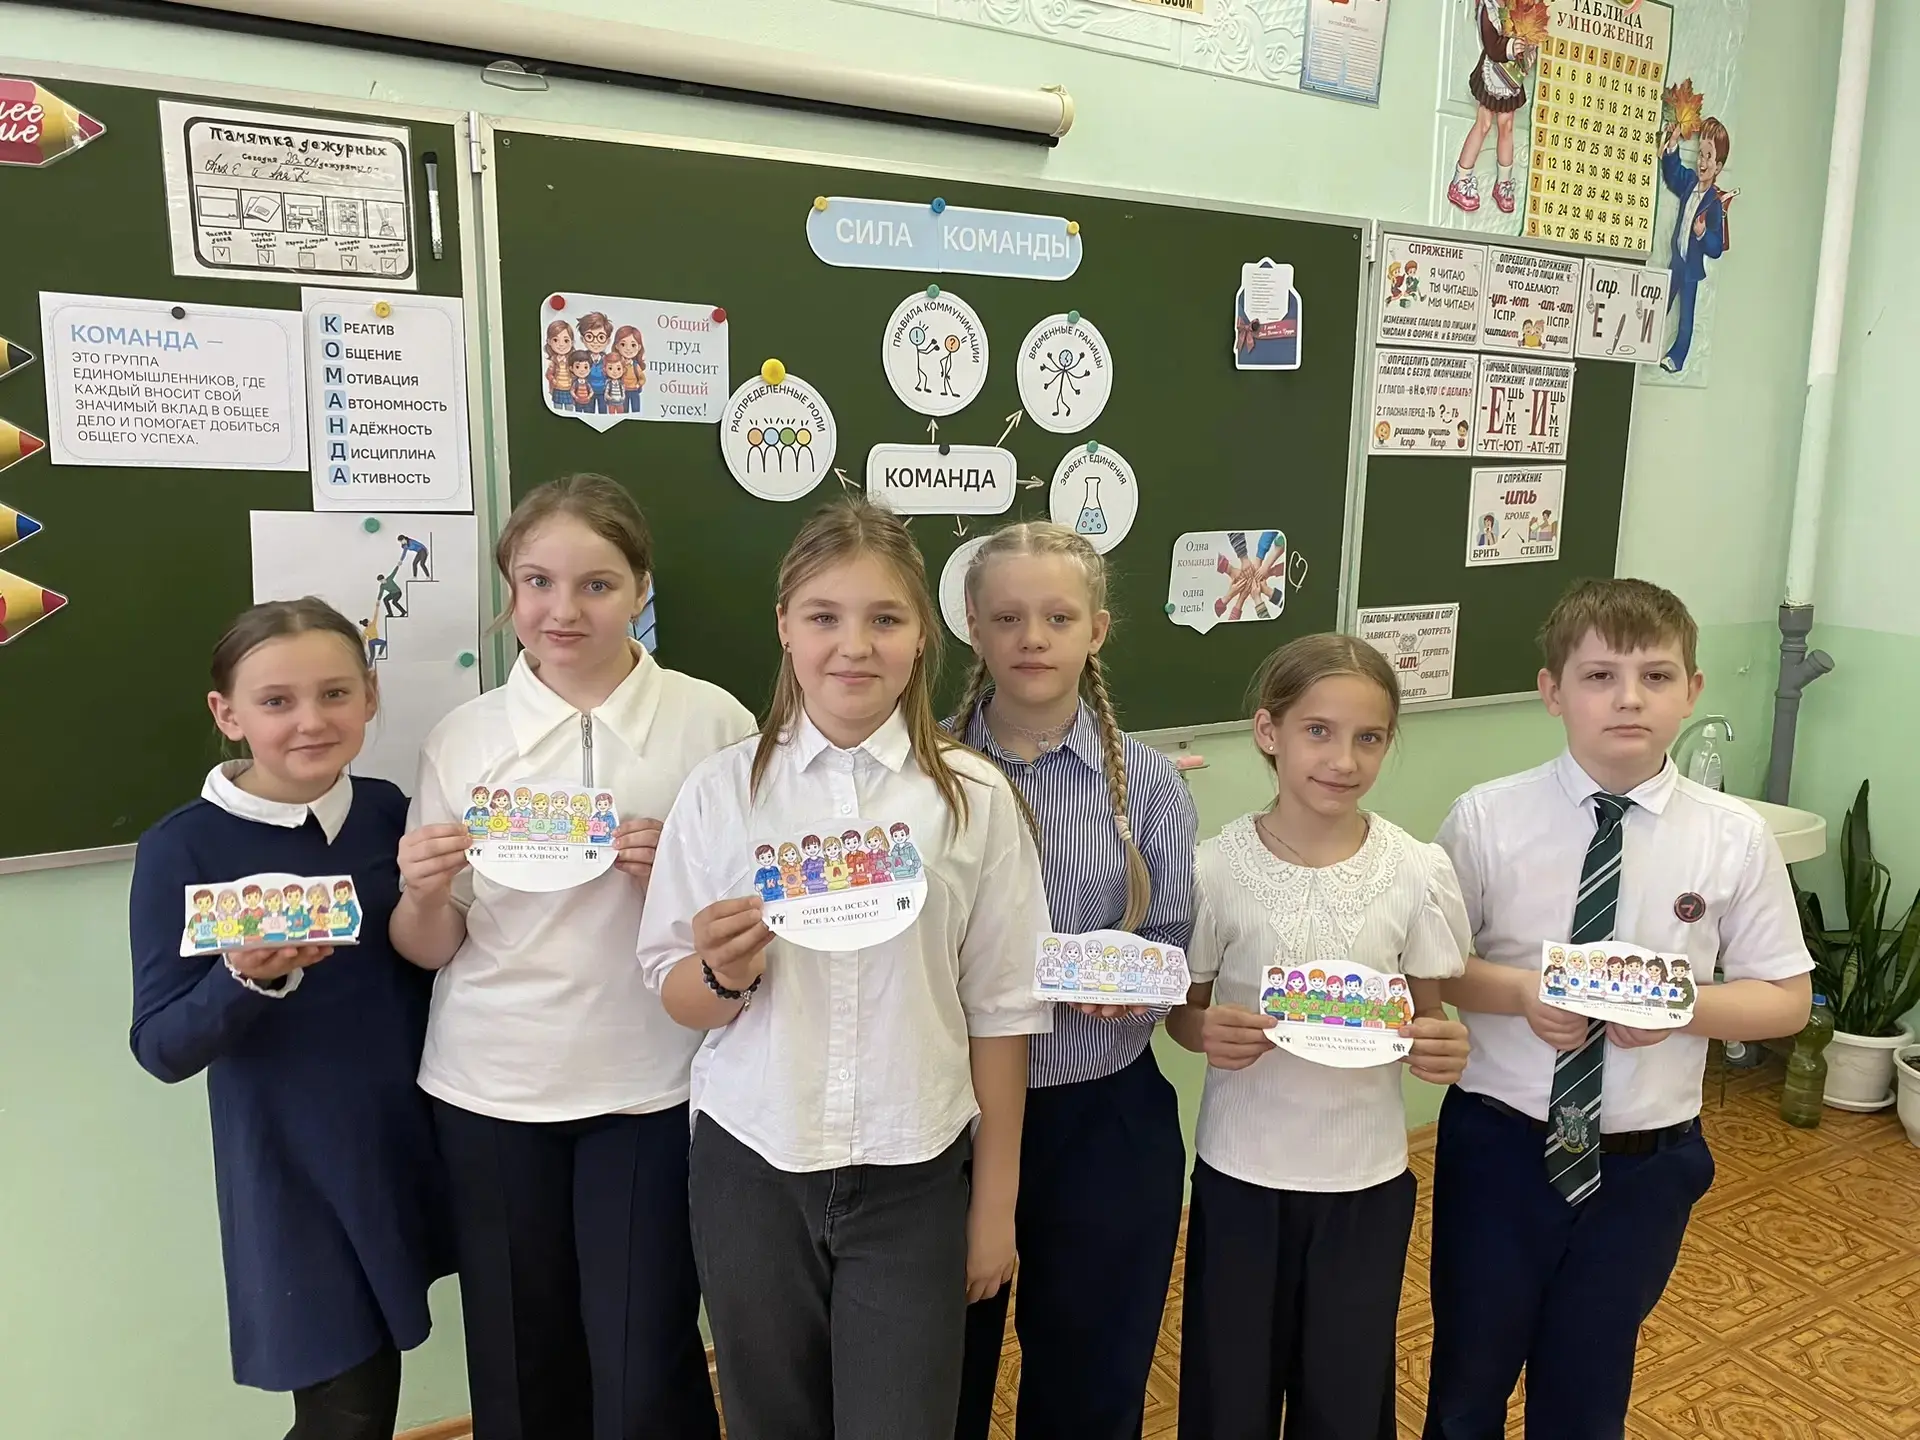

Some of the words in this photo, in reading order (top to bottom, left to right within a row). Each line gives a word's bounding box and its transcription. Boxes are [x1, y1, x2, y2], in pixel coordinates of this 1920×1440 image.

[1558, 12, 1654, 49] УМНОЖЕНИЯ
[209, 127, 294, 148] Памятка
[299, 138, 387, 156] дежурных
[242, 153, 277, 164] Сегодня
[1535, 154, 1541, 166] 6
[1547, 158, 1557, 168] 12
[1562, 160, 1572, 172] 18
[1575, 162, 1585, 174] 24
[1588, 166, 1598, 176] 30
[1601, 168, 1611, 180] 36
[1614, 170, 1624, 182] 42
[1627, 172, 1637, 184] 48
[1641, 174, 1650, 186] 54
[836, 218, 913, 247] СИЛА
[944, 226, 1070, 261] КОМАНДЫ
[1530, 222, 1537, 234] 9
[1543, 224, 1552, 236] 18
[1555, 226, 1566, 238] 27
[1569, 228, 1579, 240] 36
[1583, 230, 1593, 242] 45
[1596, 232, 1606, 244] 54
[1609, 234, 1619, 246] 63
[1623, 236, 1633, 248] 72
[1637, 238, 1646, 250] 81
[1408, 243, 1463, 259] СПРЯЖЕНИЕ
[1495, 265, 1504, 273] ПО
[1505, 266, 1526, 275] ФОРМЕ
[1500, 254, 1537, 268] ОПРЕДЕЛИТЬ
[1538, 258, 1572, 272] СПРЯЖЕНИЕ
[1430, 268, 1436, 277] Я
[1438, 269, 1465, 281] ЧИТАЮ
[1430, 282, 1440, 293] ТЫ
[1442, 285, 1478, 297] ЧИТАЕШЬ
[1508, 280, 1524, 290] ЧТО
[1525, 282, 1559, 295] ДЕЛАЮТ?
[1596, 278, 1620, 299] спр.
[1641, 285, 1663, 304] спр.
[1428, 298, 1442, 307] МЫ
[1444, 299, 1474, 310] ЧИТАЕМ
[658, 314, 710, 332] Общий
[1384, 315, 1417, 326] ИЗМЕНЕНИЕ
[1593, 302, 1605, 338] Е
[1640, 308, 1654, 344] И
[71, 324, 199, 352] КОМАНДА
[893, 306, 923, 347] ПРАВИЛА
[924, 301, 980, 363] КОММУНИКАЦИИ
[667, 341, 700, 355] труд
[1029, 326, 1073, 360] ВРЕМЕННЫЕ
[1074, 329, 1103, 368] ГРАНИЦЫ
[72, 352, 100, 363] ЭТО
[104, 354, 159, 367] ГРУППА
[1388, 355, 1429, 366] ОПРЕДЕЛИТЬ
[1430, 357, 1467, 368] СПРЯЖЕНИЕ
[649, 360, 719, 375] приносит
[1379, 366, 1405, 376] ГЛАГОЛА
[1511, 364, 1542, 375] ОКОНЧАНИЯ
[1543, 366, 1569, 378] ГЛАГОЛОВ
[73, 368, 239, 388] ЕДИНОМЫШЛЕННИКОВ,
[242, 377, 266, 389] ГДЕ
[1490, 374, 1525, 385] СПРЯЖЕНИЕ
[1535, 378, 1568, 389] СПРЯЖЕНИЕ
[74, 384, 140, 398] КАЖДЫЙ
[144, 387, 201, 400] ВНОСИТ
[205, 387, 241, 401] СВОЙ
[660, 380, 708, 395] общий
[1508, 388, 1524, 399] ШЬ
[1551, 391, 1566, 402] ШЬ
[75, 399, 157, 414] ЗНАЧИМЫЙ
[162, 404, 208, 416] ВКЛАД
[212, 405, 220, 415] В
[223, 406, 269, 419] ОБЩЕЕ
[660, 403, 707, 417] успех!
[731, 384, 809, 432] РАСПРЕДЕЛЕННЫЕ
[807, 402, 825, 432] РОЛИ
[1507, 400, 1513, 410] Т
[1551, 403, 1556, 413] Т
[77, 415, 115, 428] ДЕЛО
[120, 417, 130, 427] И
[134, 418, 206, 430] ПОМОГАЕТ
[210, 420, 280, 433] ДОБИТЬСЯ
[1506, 412, 1515, 422] М
[1550, 415, 1558, 425] М
[1394, 427, 1425, 437] решать
[1505, 424, 1516, 435] ТЕ
[1549, 427, 1559, 437] ТЕ
[78, 430, 137, 444] ОБЩЕГО
[141, 432, 199, 445] УСПЕХА.
[1061, 455, 1087, 485] ЭФФЕКТ
[1090, 454, 1126, 485] ЕДИНЕНИЯ
[885, 468, 996, 492] КОМАНДА
[1504, 473, 1542, 483] СПРЯЖЕНИЕ
[1500, 490, 1537, 505] -ить
[1505, 512, 1530, 520] КРОМЕ
[1186, 541, 1209, 552] Одна
[1473, 548, 1500, 558] БРИТЬ
[1521, 545, 1554, 555] СТЕЛИТЬ
[1177, 558, 1215, 567] команда
[1183, 588, 1204, 598] одна
[1180, 602, 1204, 613] цель!
[1362, 611, 1434, 624] ГЛАГОЛЫ-ИСКЛЮЧЕНИЯ
[1365, 631, 1400, 640] ЗАВИСЕТЬ
[1418, 627, 1451, 636] СМОТРЕТЬ
[1422, 648, 1449, 657] ТЕРПЕТЬ
[1420, 670, 1449, 679] ОБИДЕТЬ
[802, 907, 829, 916] ОДИН
[830, 905, 842, 914] ЗА
[845, 901, 869, 910] ВСЕХ
[824, 916, 836, 924] ЗА
[838, 911, 879, 922] ОДНОГО!
